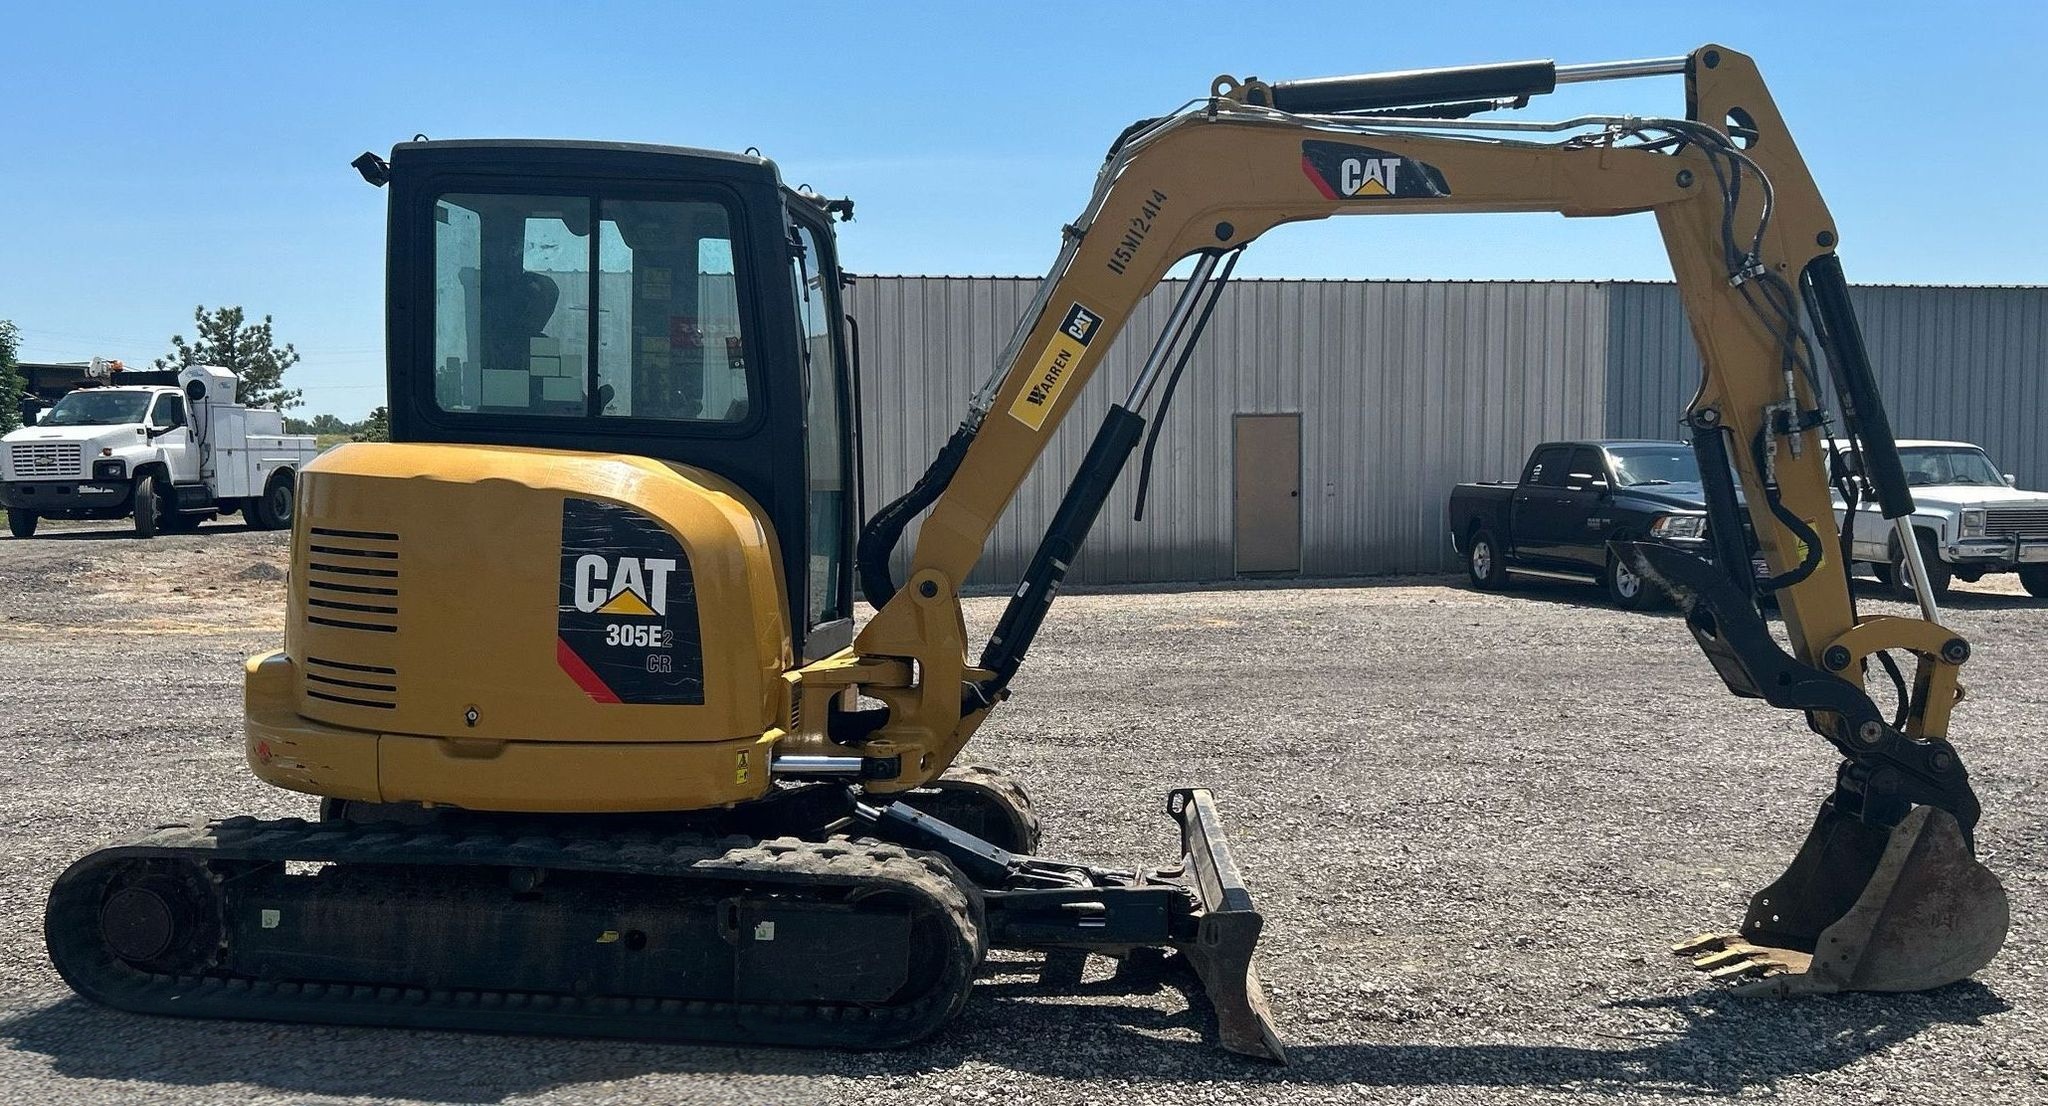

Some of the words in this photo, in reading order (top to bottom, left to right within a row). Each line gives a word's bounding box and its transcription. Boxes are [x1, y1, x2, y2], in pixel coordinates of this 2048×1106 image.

[1341, 158, 1401, 196] CAT
[1026, 349, 1072, 406] WARREN
[1068, 310, 1095, 340] CAT
[574, 554, 676, 616] CAT
[646, 654, 672, 673] CR
